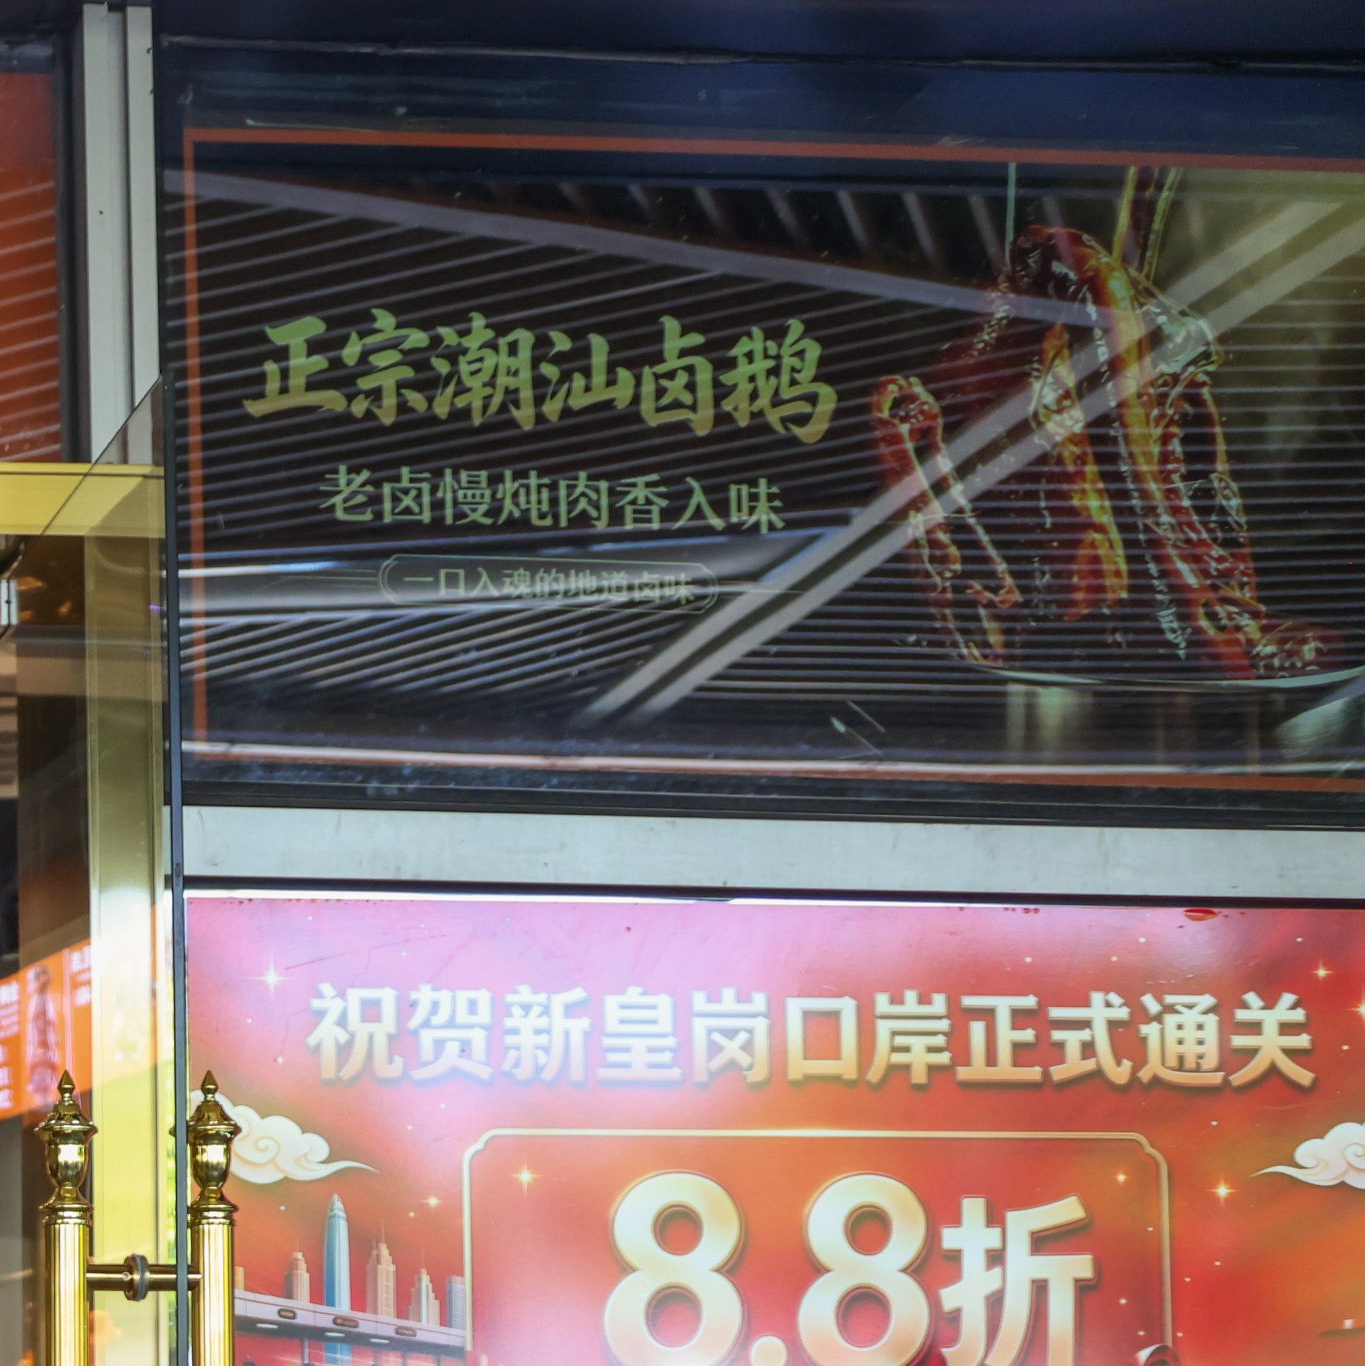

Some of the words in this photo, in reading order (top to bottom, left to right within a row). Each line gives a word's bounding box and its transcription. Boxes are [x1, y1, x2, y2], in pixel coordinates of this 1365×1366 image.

[243, 306, 839, 445] 正宗潮汕卤鹅
[319, 463, 787, 535] 老卤慢炖肉香入味
[403, 567, 695, 605] 一口入魂的地道卤味
[304, 983, 1316, 1089] 祝贺新皇岗口岸正式通关
